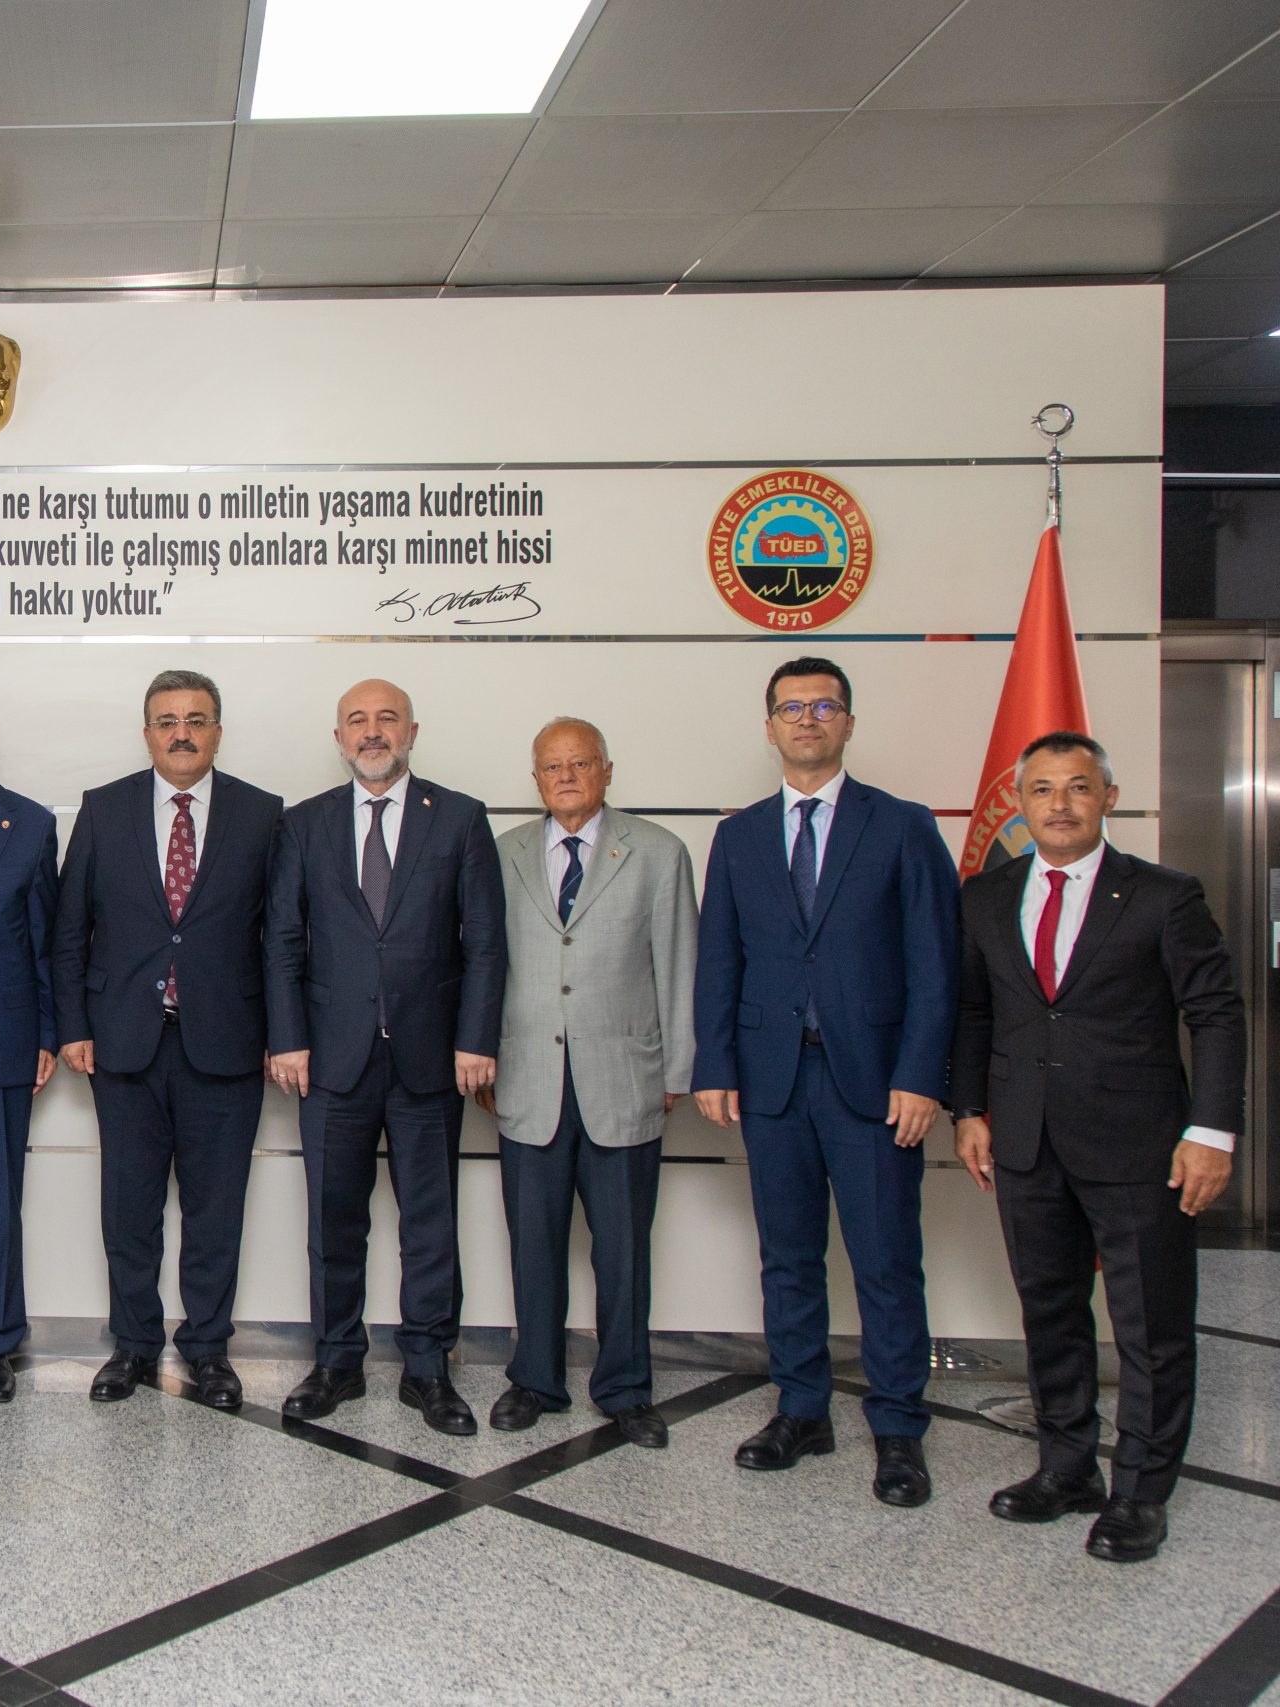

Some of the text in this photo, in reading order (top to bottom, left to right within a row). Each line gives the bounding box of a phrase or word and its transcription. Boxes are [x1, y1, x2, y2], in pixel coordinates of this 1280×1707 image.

[40, 486, 96, 529] karşı
[106, 487, 188, 520] tutumu
[198, 493, 211, 519] o
[221, 485, 308, 519] milletin
[319, 490, 410, 527] yaşama
[420, 482, 543, 517] kudretinin
[87, 532, 113, 566] ile
[123, 532, 220, 575] çalışmış
[230, 532, 327, 566] olanlara
[338, 531, 395, 574] karşı
[406, 530, 487, 565] minnet
[497, 529, 552, 564] hissi
[712, 475, 867, 602] TÜRKİYE EMEKLİLER DERNEĞİ
[768, 537, 817, 553] TÜED
[10, 582, 73, 616] hakkı
[766, 611, 813, 627] 1970
